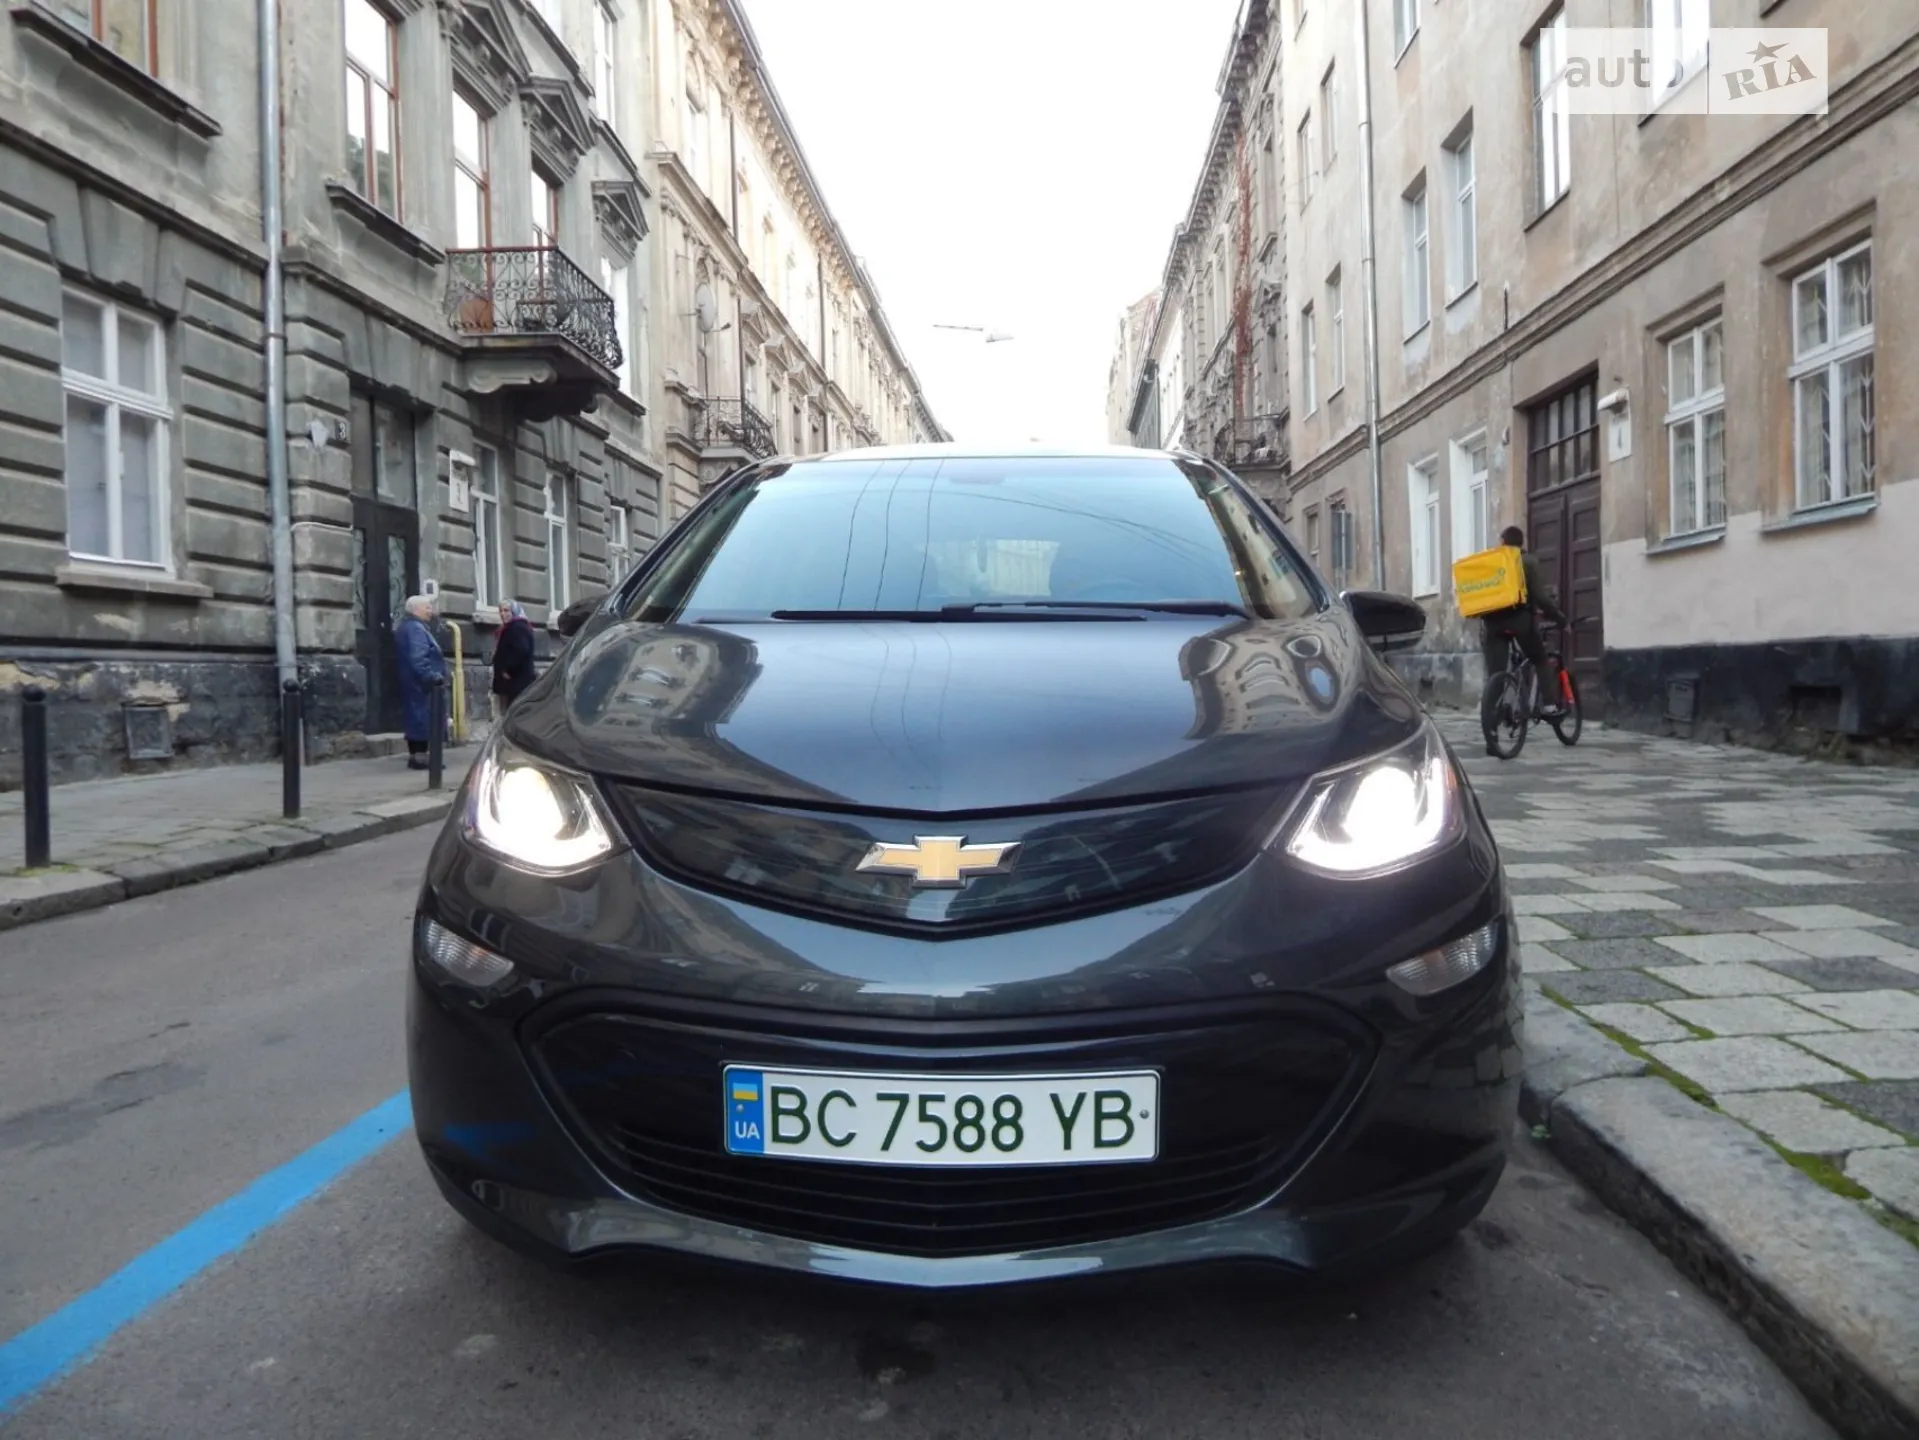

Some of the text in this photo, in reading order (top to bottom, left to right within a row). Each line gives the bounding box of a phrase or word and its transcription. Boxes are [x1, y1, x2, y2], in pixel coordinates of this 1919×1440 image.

[735, 1120, 760, 1140] UA
[770, 1085, 1135, 1153] BC 7588 YB
